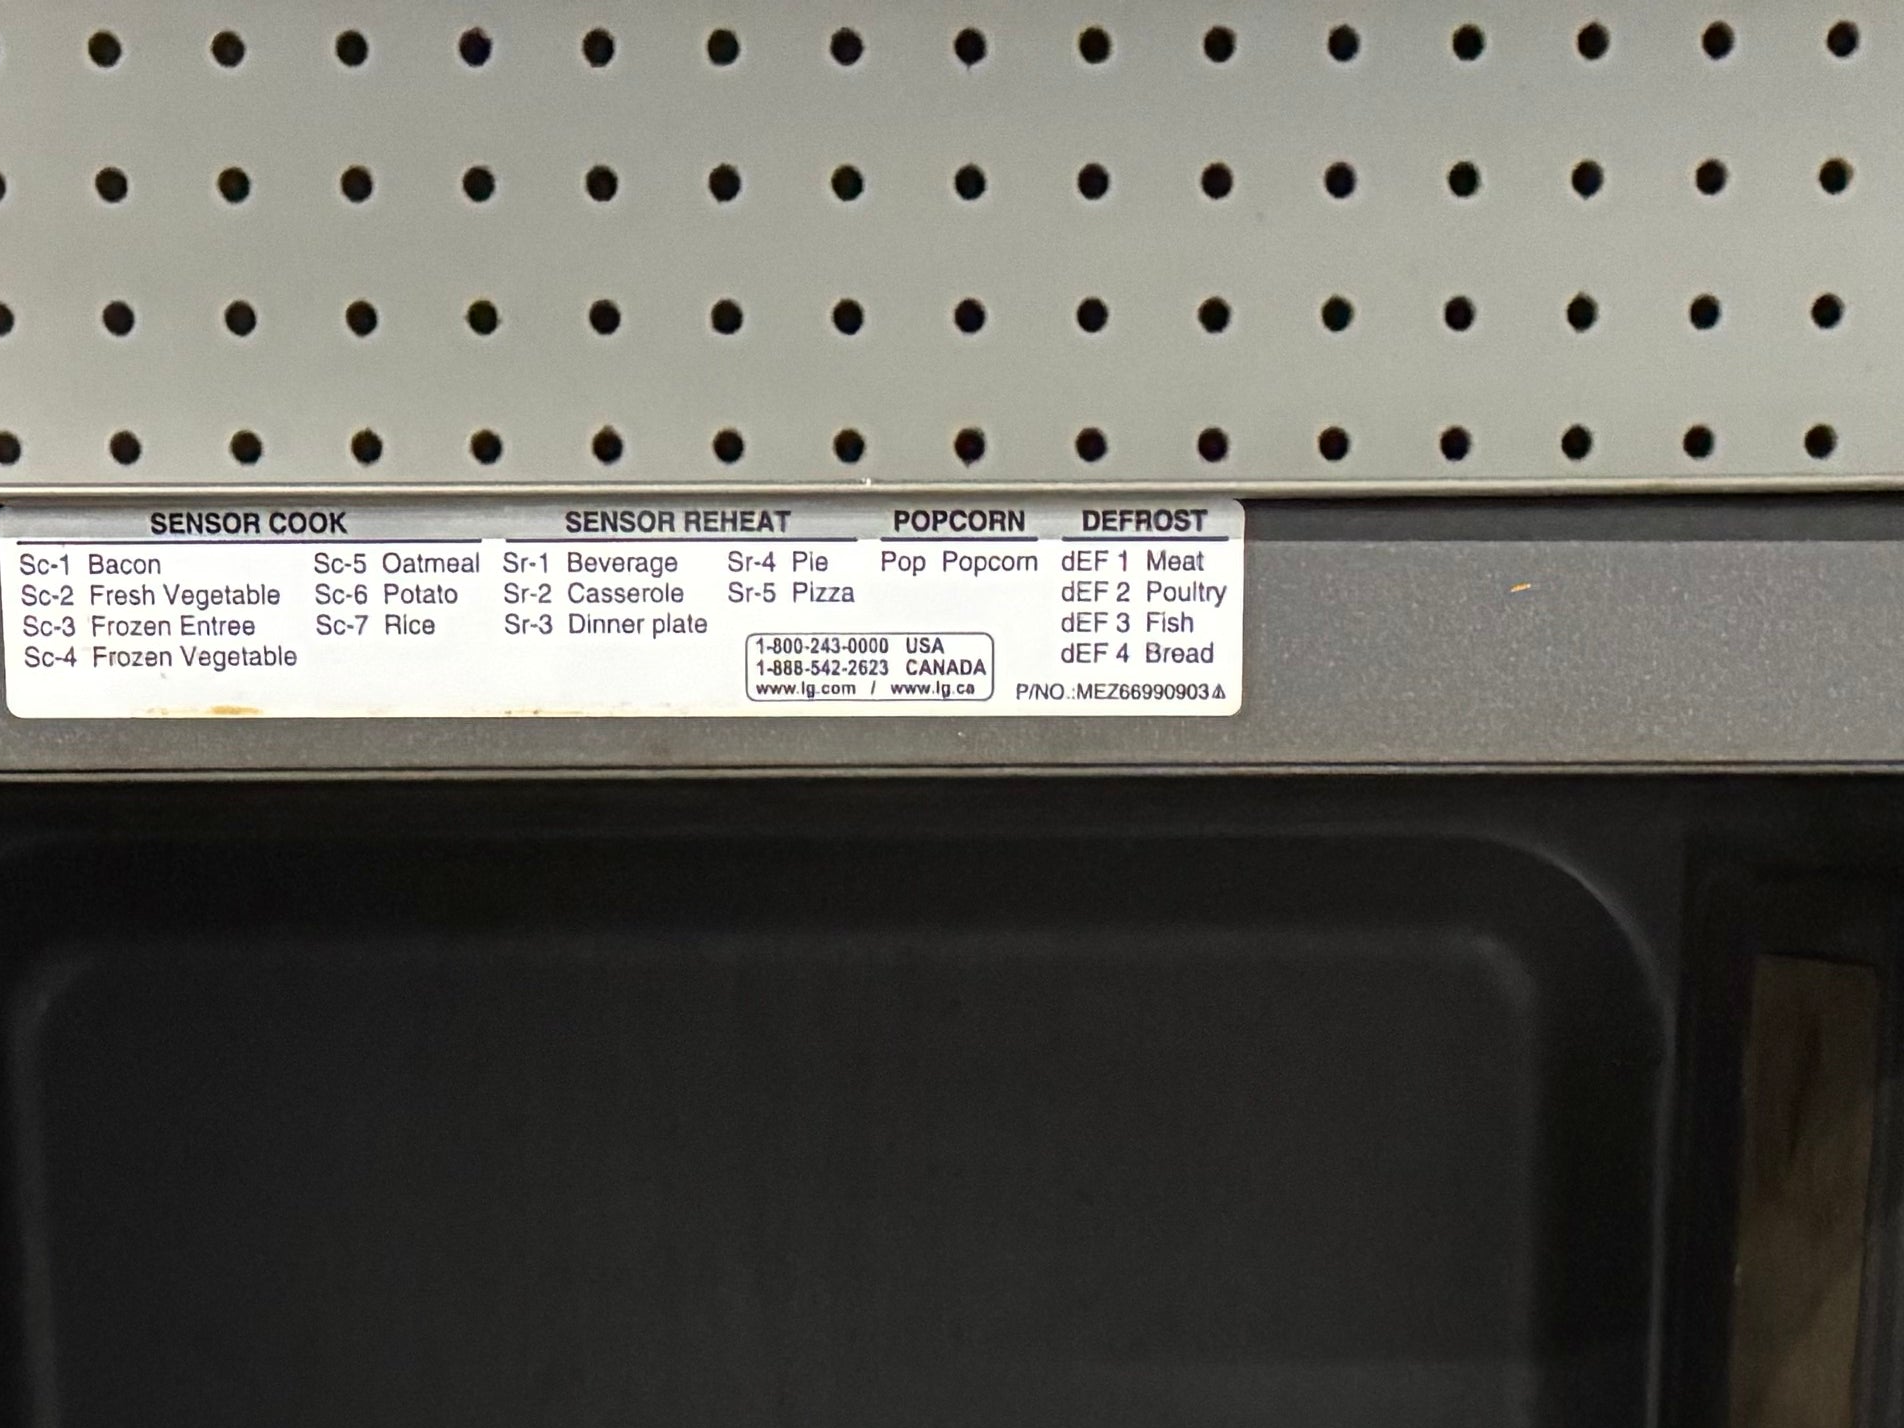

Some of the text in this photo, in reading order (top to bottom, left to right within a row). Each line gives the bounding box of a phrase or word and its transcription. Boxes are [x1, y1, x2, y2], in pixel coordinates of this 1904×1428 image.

[149, 511, 348, 535] SENSOR COOK
[564, 509, 792, 534] SENSOR REHEAT
[893, 508, 1026, 533] POPCORN
[1081, 507, 1209, 532] DEFROST
[19, 552, 161, 576] Sc-1 Bacon
[314, 551, 480, 575] Sc-5 Oatmeal
[502, 551, 678, 579] Sr-1 Beverage
[727, 550, 829, 573] Sr-4 Pie
[881, 550, 1038, 578] Pop Popcorn
[1061, 549, 1205, 572] dEF 1 Meat
[21, 583, 281, 612] Sc-2 Fresh Vegetable
[315, 582, 458, 606] Sc-6 Potato
[503, 581, 685, 605] Sr-2 Casserole
[727, 580, 856, 604] Sr-5 Pizza
[1061, 580, 1228, 609] dEF 2 Poultry
[22, 614, 256, 638] Sc-3 Frozen Entree
[316, 613, 436, 636] Sc-7 Rice
[504, 612, 708, 640] Sr-3 Dinner plate
[1061, 611, 1194, 634] dEF 3 Fish
[755, 636, 945, 655] 1-800-243-0000 USA
[1060, 641, 1214, 664] dEF 4 Bread
[24, 644, 298, 673] Sc-4 Frozen Vegetable
[756, 658, 987, 677] 1-888-542-2623 CANADA
[755, 680, 857, 699] www.lg.com
[890, 680, 976, 699] www.lg.ca
